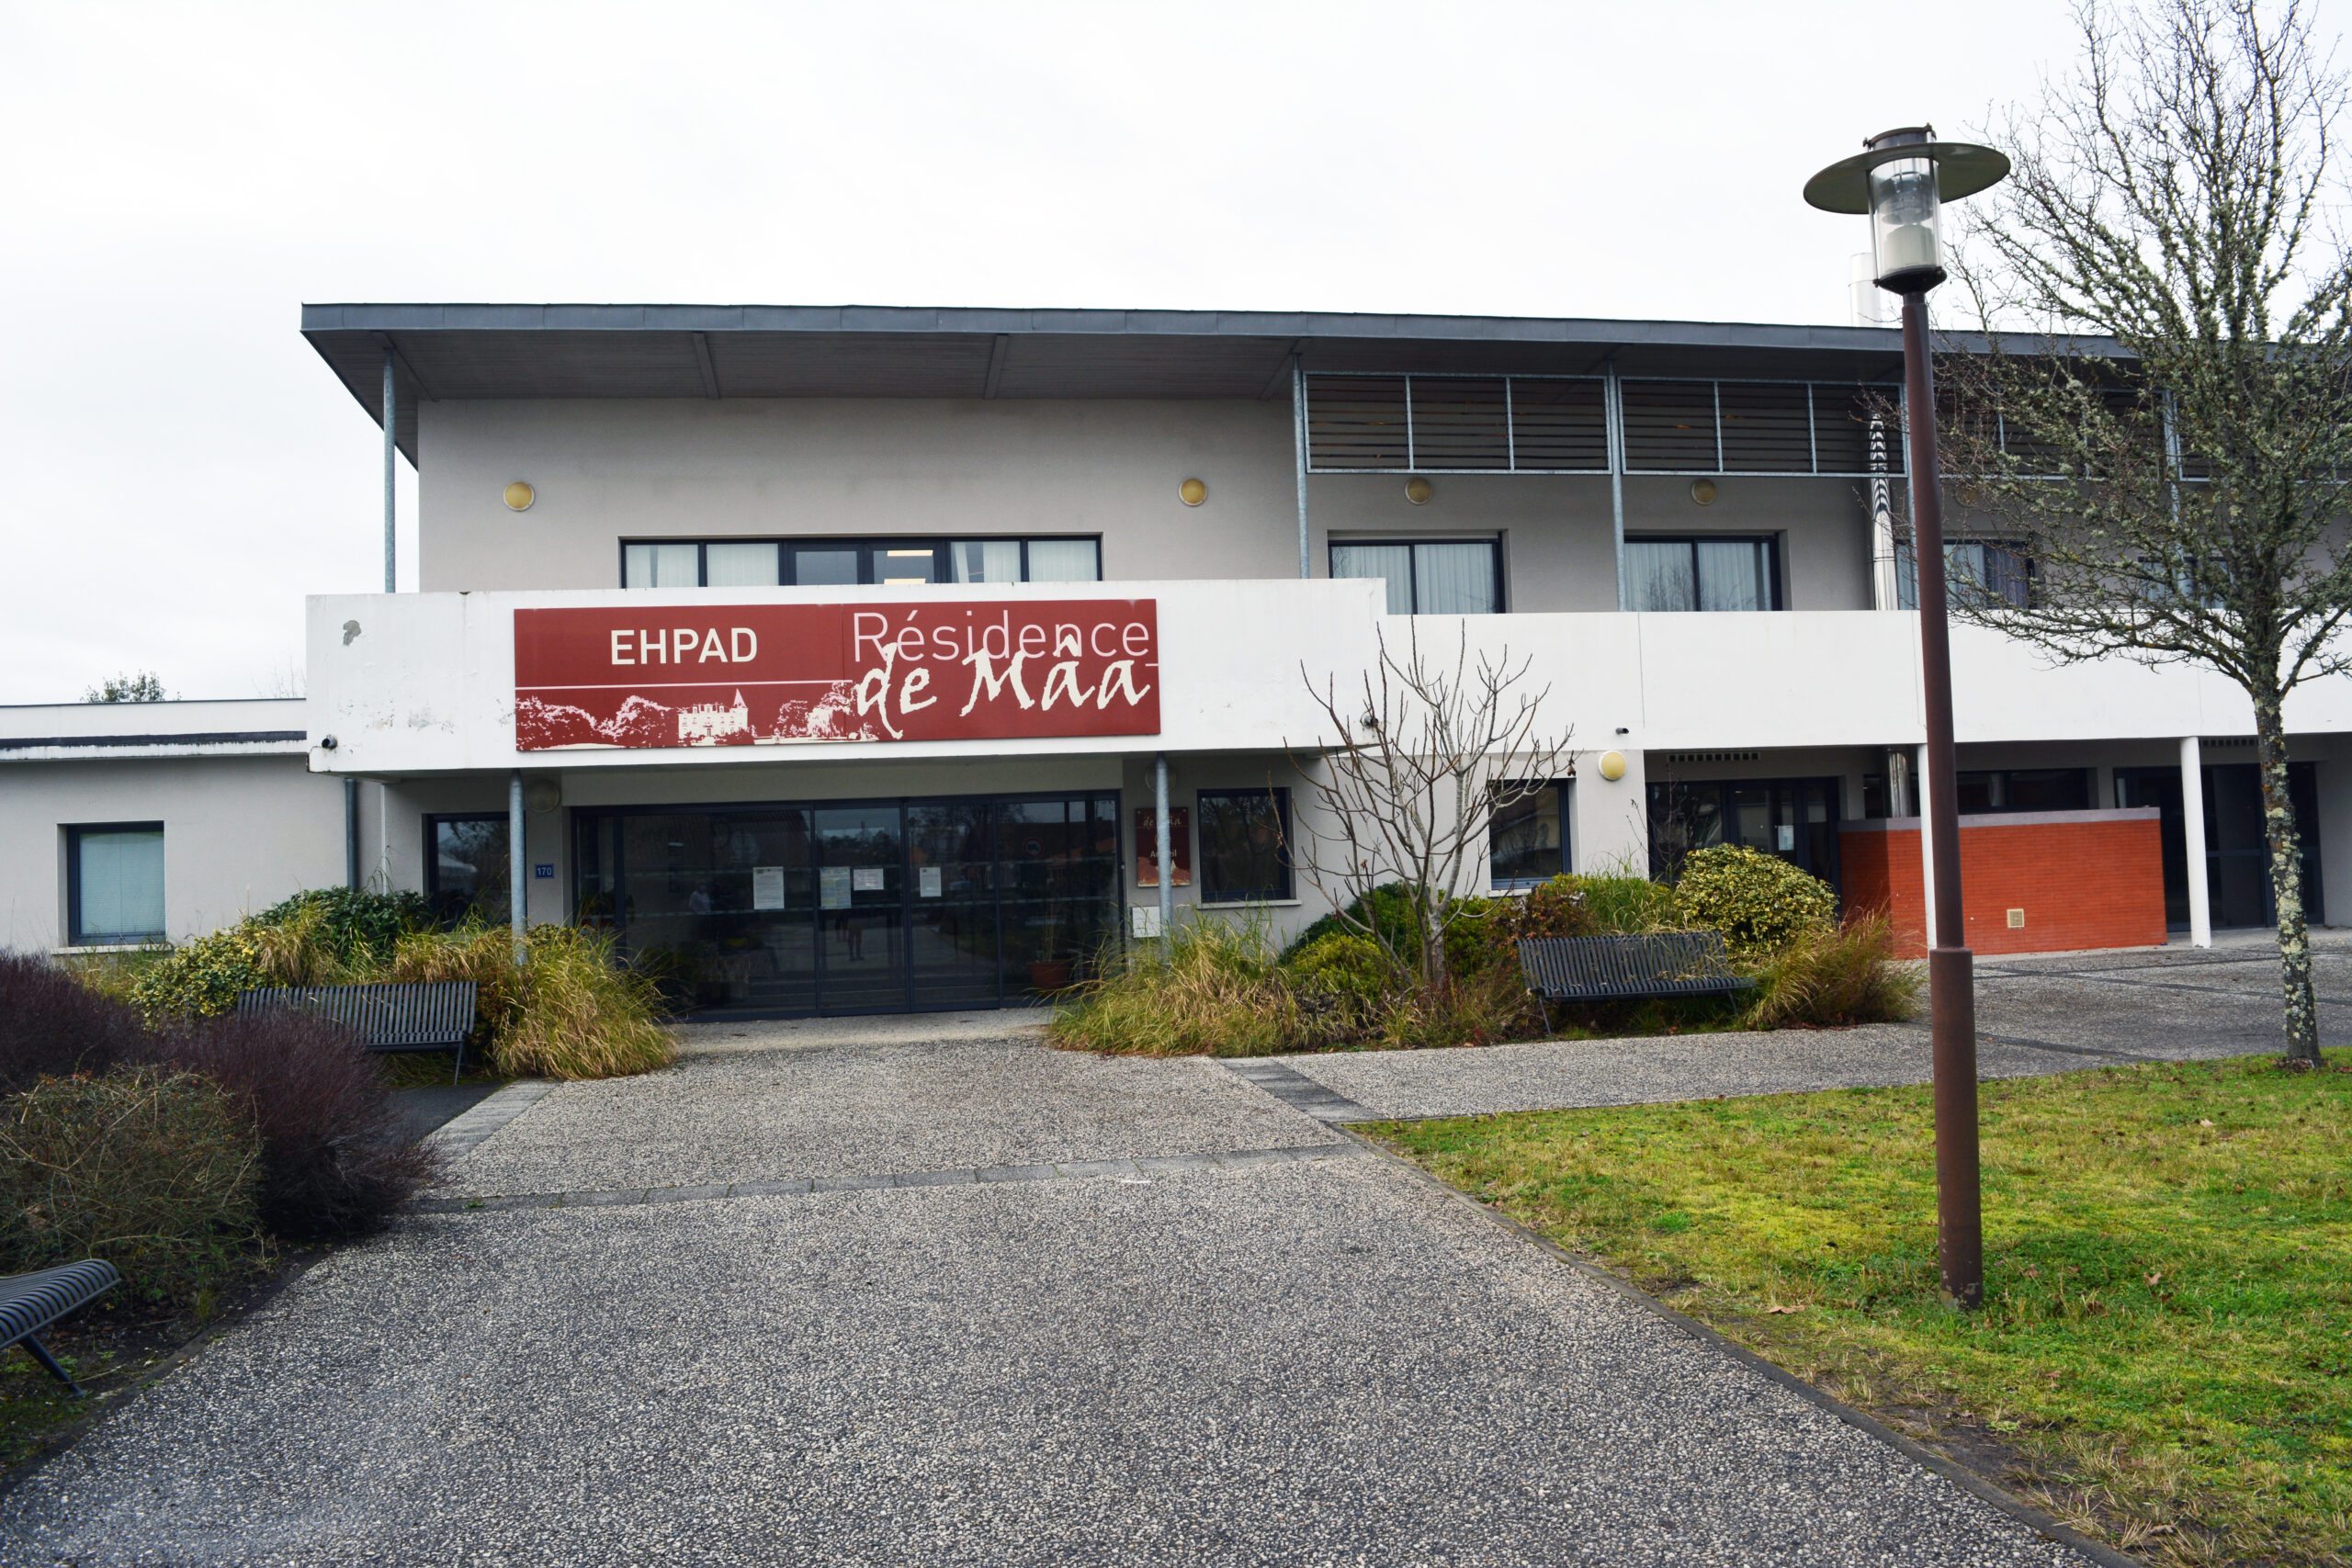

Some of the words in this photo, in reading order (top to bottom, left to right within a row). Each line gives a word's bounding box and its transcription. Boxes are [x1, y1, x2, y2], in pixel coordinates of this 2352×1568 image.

[611, 627, 758, 665] EHPAD
[854, 610, 1149, 662] Résidence
[855, 642, 937, 739] de
[959, 634, 1151, 717] Mâa
[537, 866, 552, 875] 170
